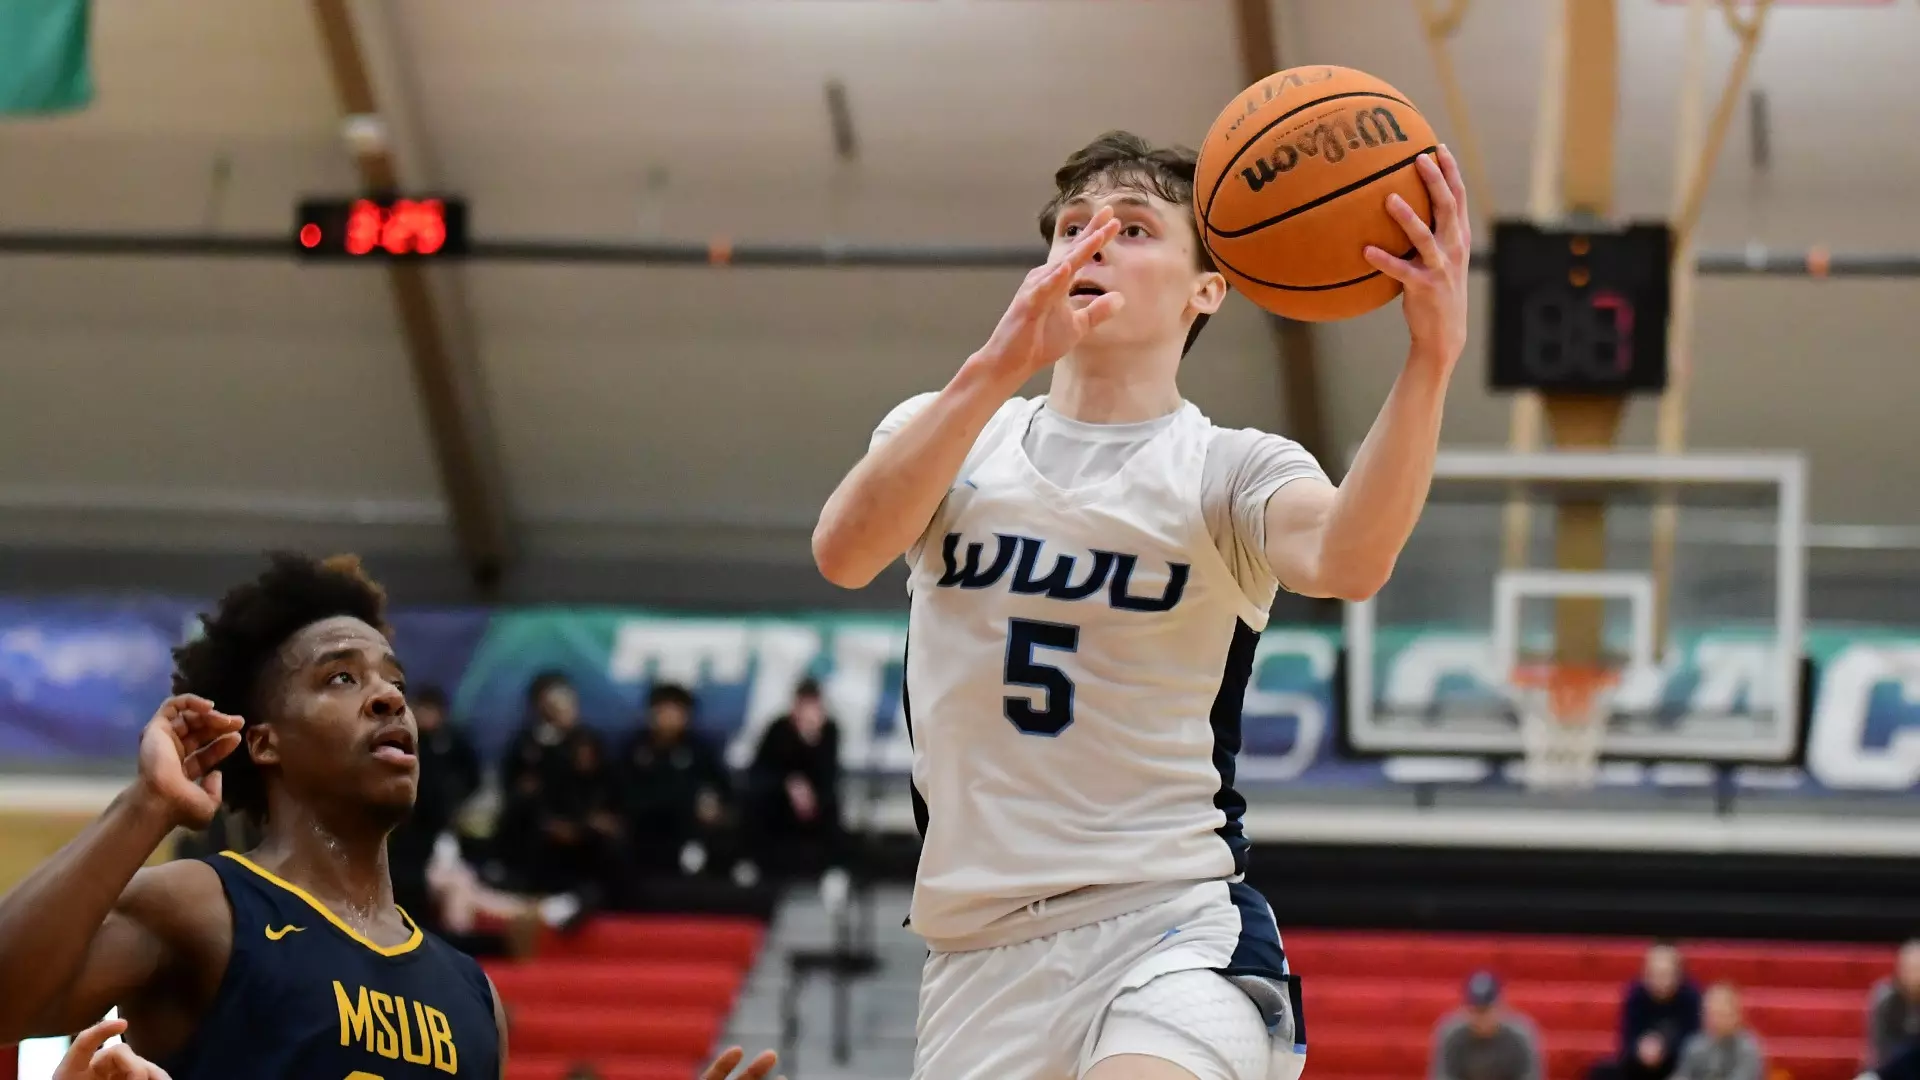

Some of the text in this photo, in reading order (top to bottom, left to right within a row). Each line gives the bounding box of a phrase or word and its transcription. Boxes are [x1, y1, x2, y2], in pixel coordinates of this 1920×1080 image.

[1240, 107, 1409, 192] Wilson
[936, 532, 1191, 612] WWU
[1003, 616, 1080, 737] 5
[332, 980, 458, 1075] MSUB
